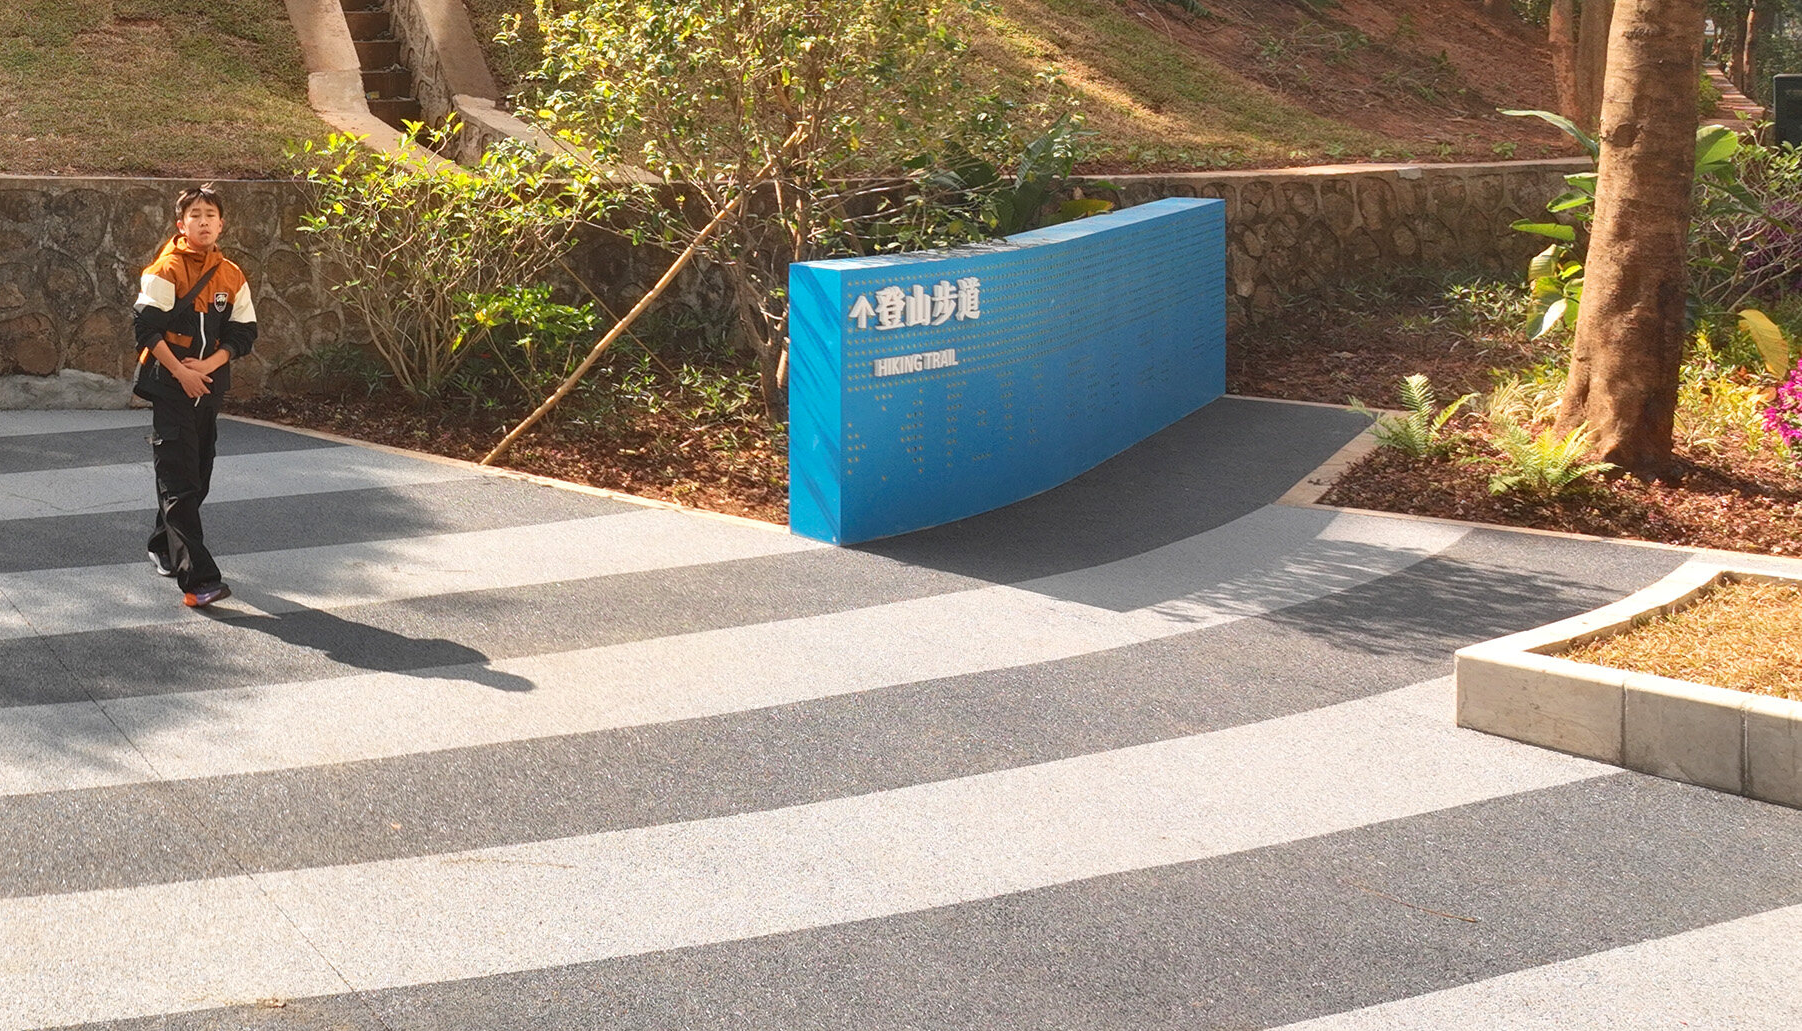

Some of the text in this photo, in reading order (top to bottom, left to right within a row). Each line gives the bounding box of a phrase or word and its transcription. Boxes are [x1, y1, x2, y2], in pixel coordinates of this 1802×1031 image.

[876, 277, 980, 330] 登山步道
[874, 349, 958, 377] HIKING TRAIL
